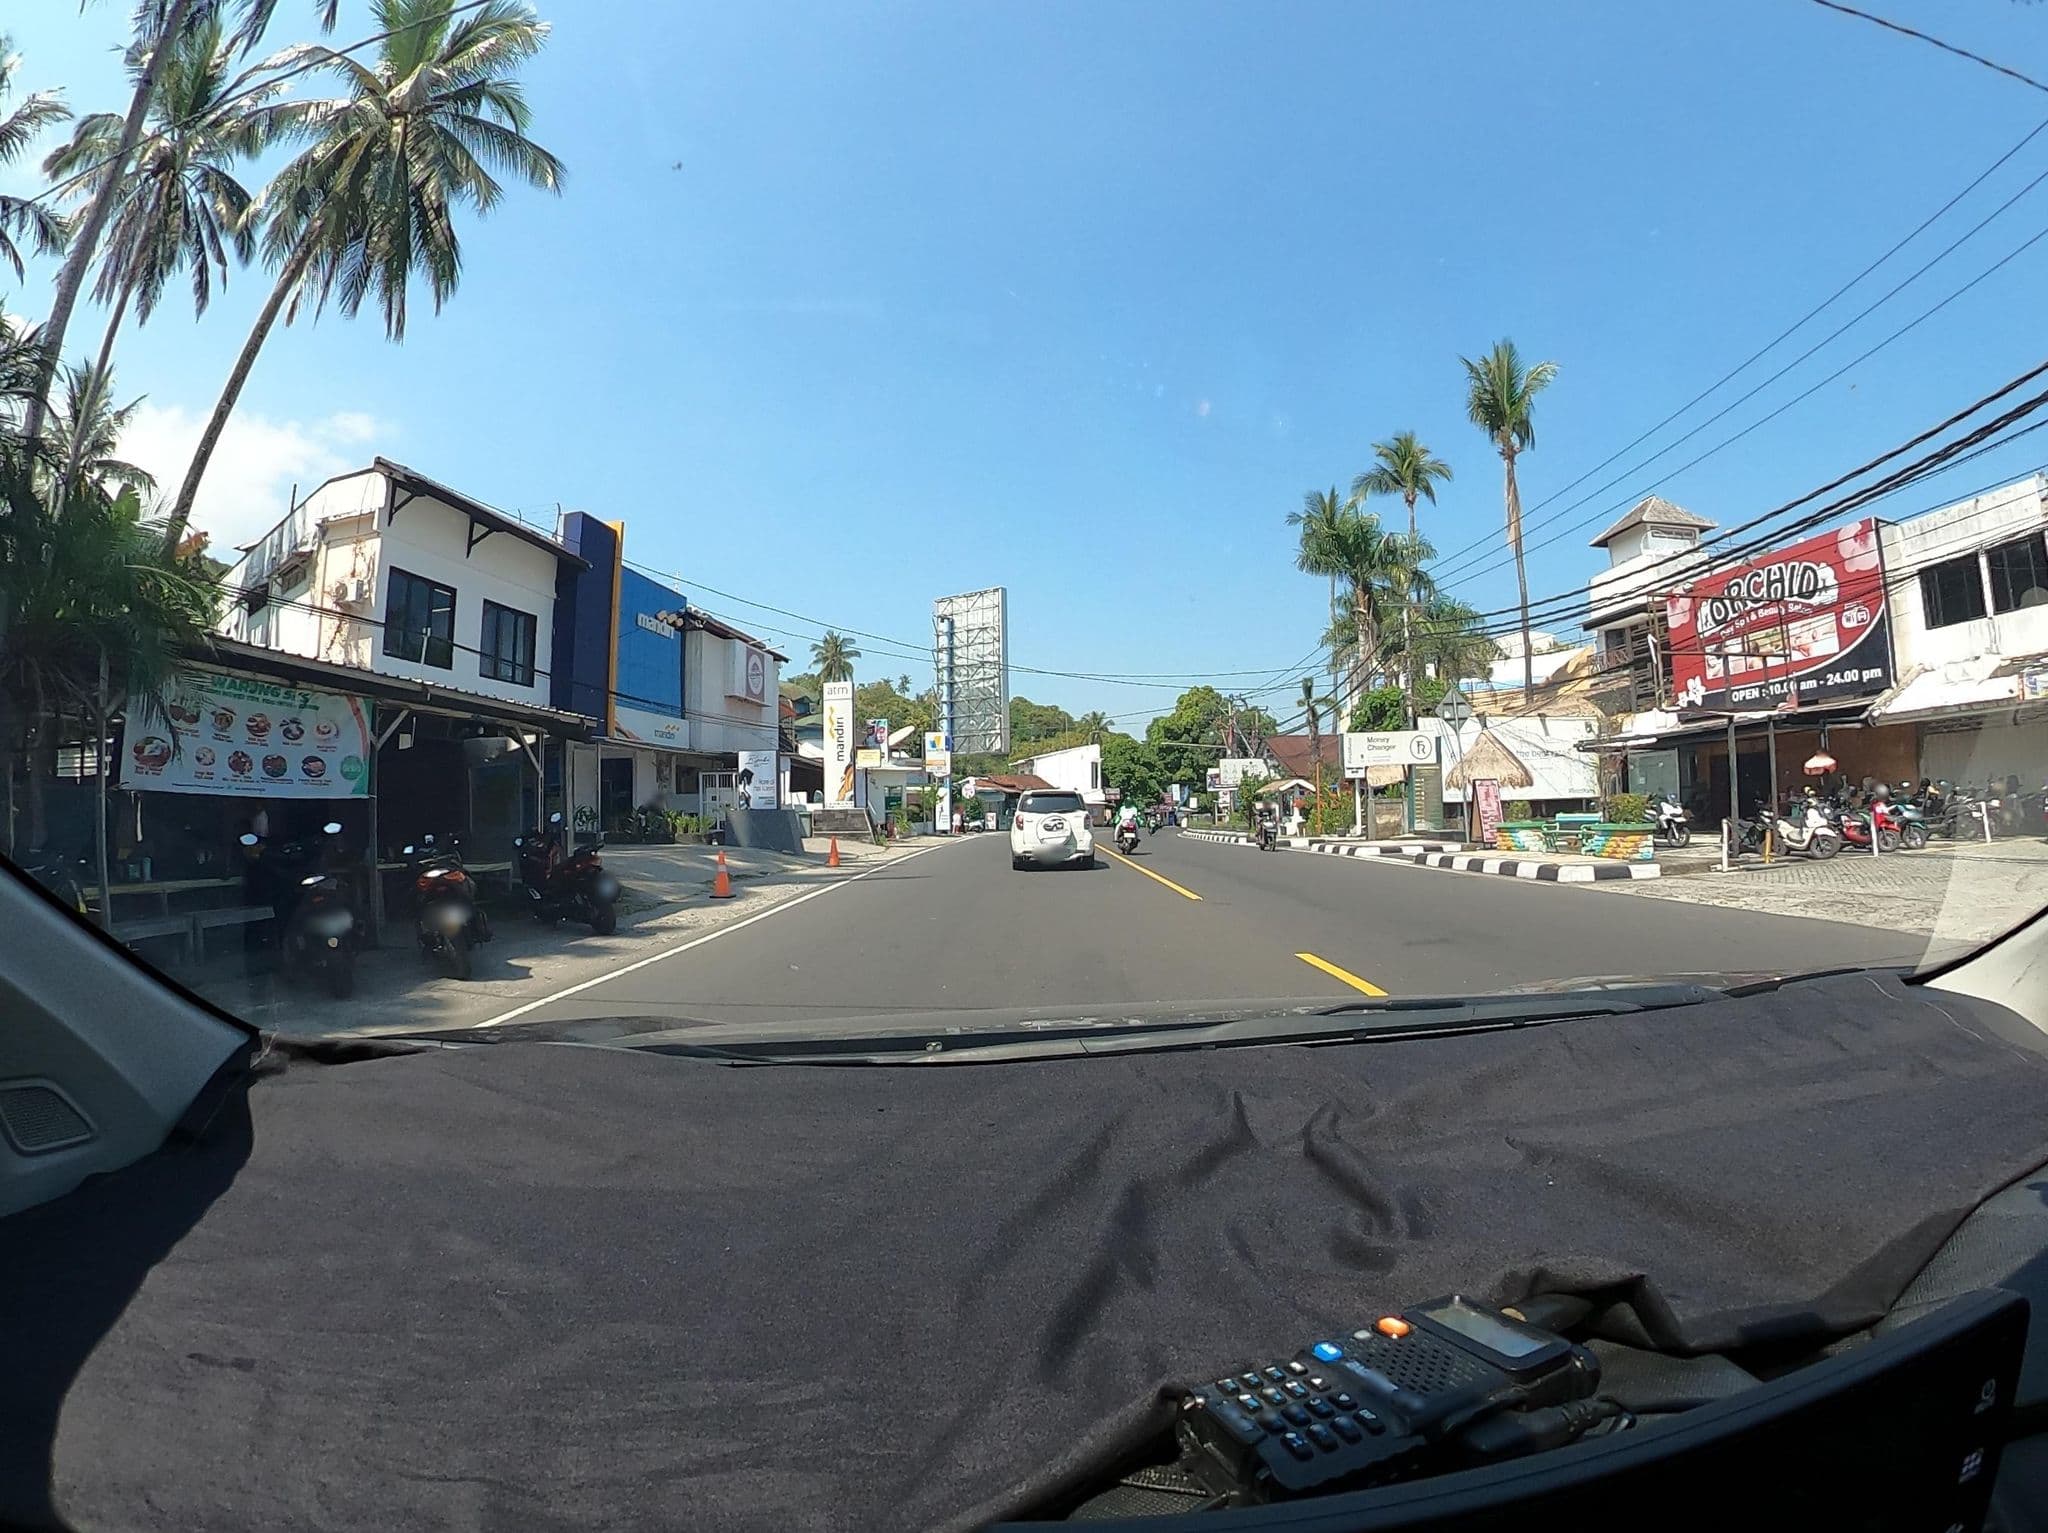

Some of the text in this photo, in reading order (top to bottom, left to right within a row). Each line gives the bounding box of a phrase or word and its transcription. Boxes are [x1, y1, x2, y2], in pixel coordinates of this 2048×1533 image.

[1709, 561, 1820, 625] ORCHID
[637, 611, 675, 640] mandiri
[1757, 603, 1785, 619] Beauy
[827, 685, 849, 696] atm
[1731, 688, 1760, 702] OPEN
[1799, 680, 1817, 690] am
[1826, 670, 1859, 686] 24.00
[1862, 668, 1882, 683] pm
[834, 716, 845, 762] mandiri
